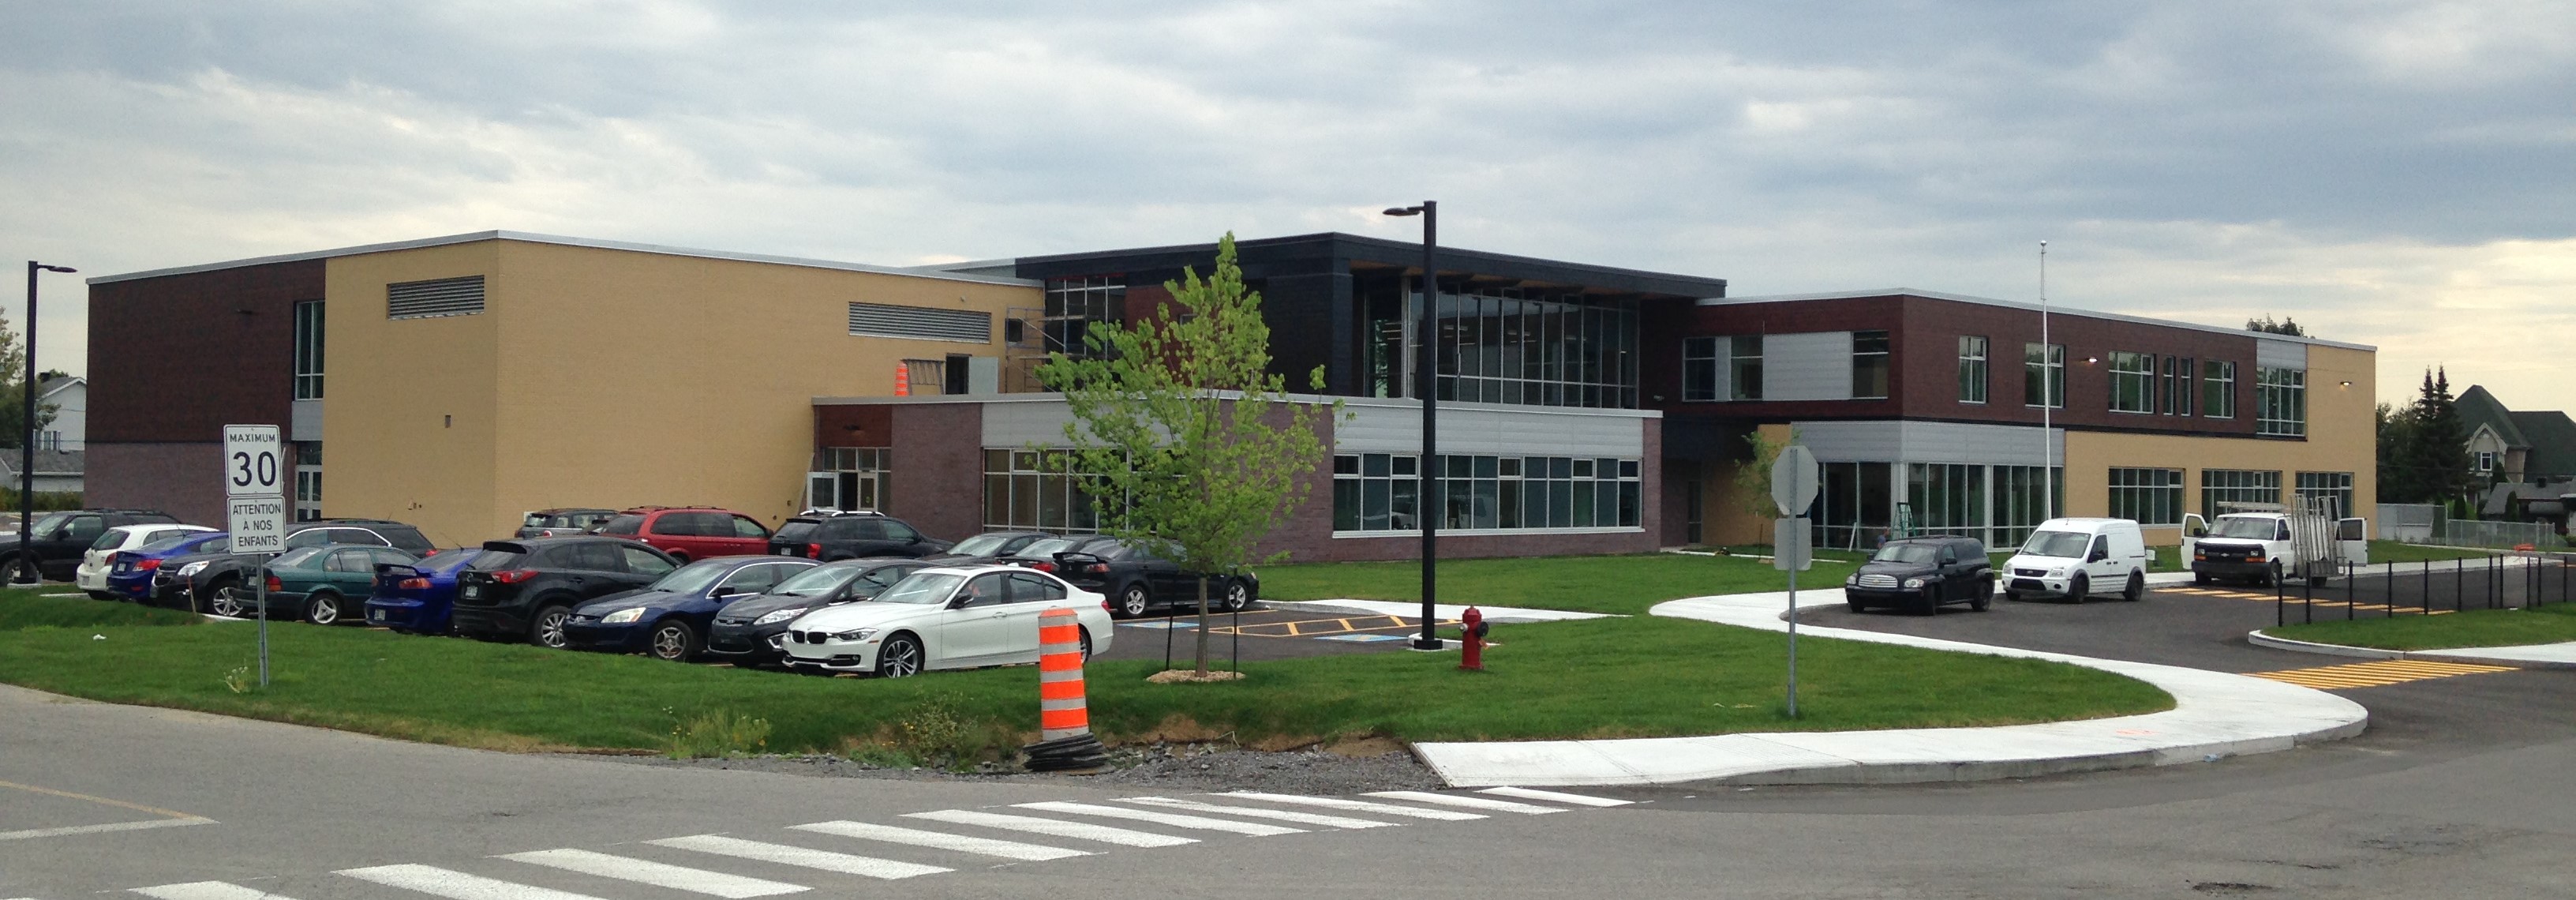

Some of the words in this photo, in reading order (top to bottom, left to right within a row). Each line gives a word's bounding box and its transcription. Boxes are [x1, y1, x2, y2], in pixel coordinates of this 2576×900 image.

[230, 433, 275, 442] MAXIMUM
[233, 451, 276, 486] 30
[233, 504, 281, 515] ATTENTION
[253, 519, 272, 531] NOS
[238, 535, 278, 547] ENFANTS
